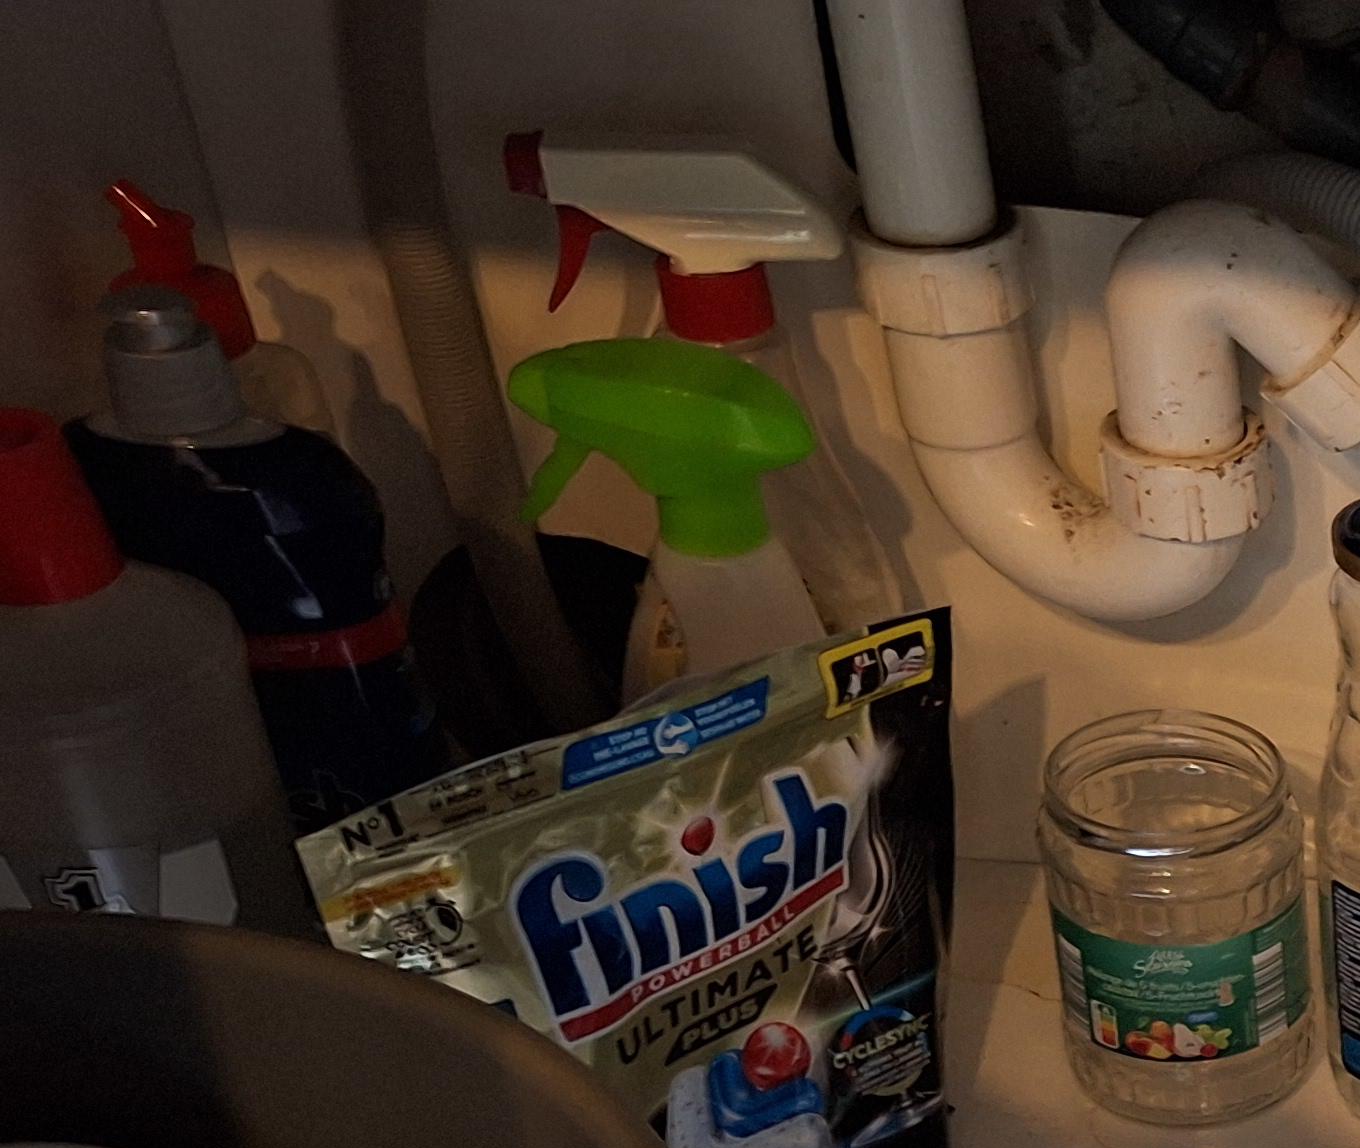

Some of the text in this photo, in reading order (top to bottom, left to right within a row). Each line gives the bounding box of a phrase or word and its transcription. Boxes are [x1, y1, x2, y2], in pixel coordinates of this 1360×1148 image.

[516, 774, 850, 1021] finish
[615, 924, 817, 1066] ULTIMATE
[629, 904, 796, 1003] POWERBALL
[680, 997, 759, 1052] PLUS
[832, 1012, 931, 1071] CYCLESYNC
